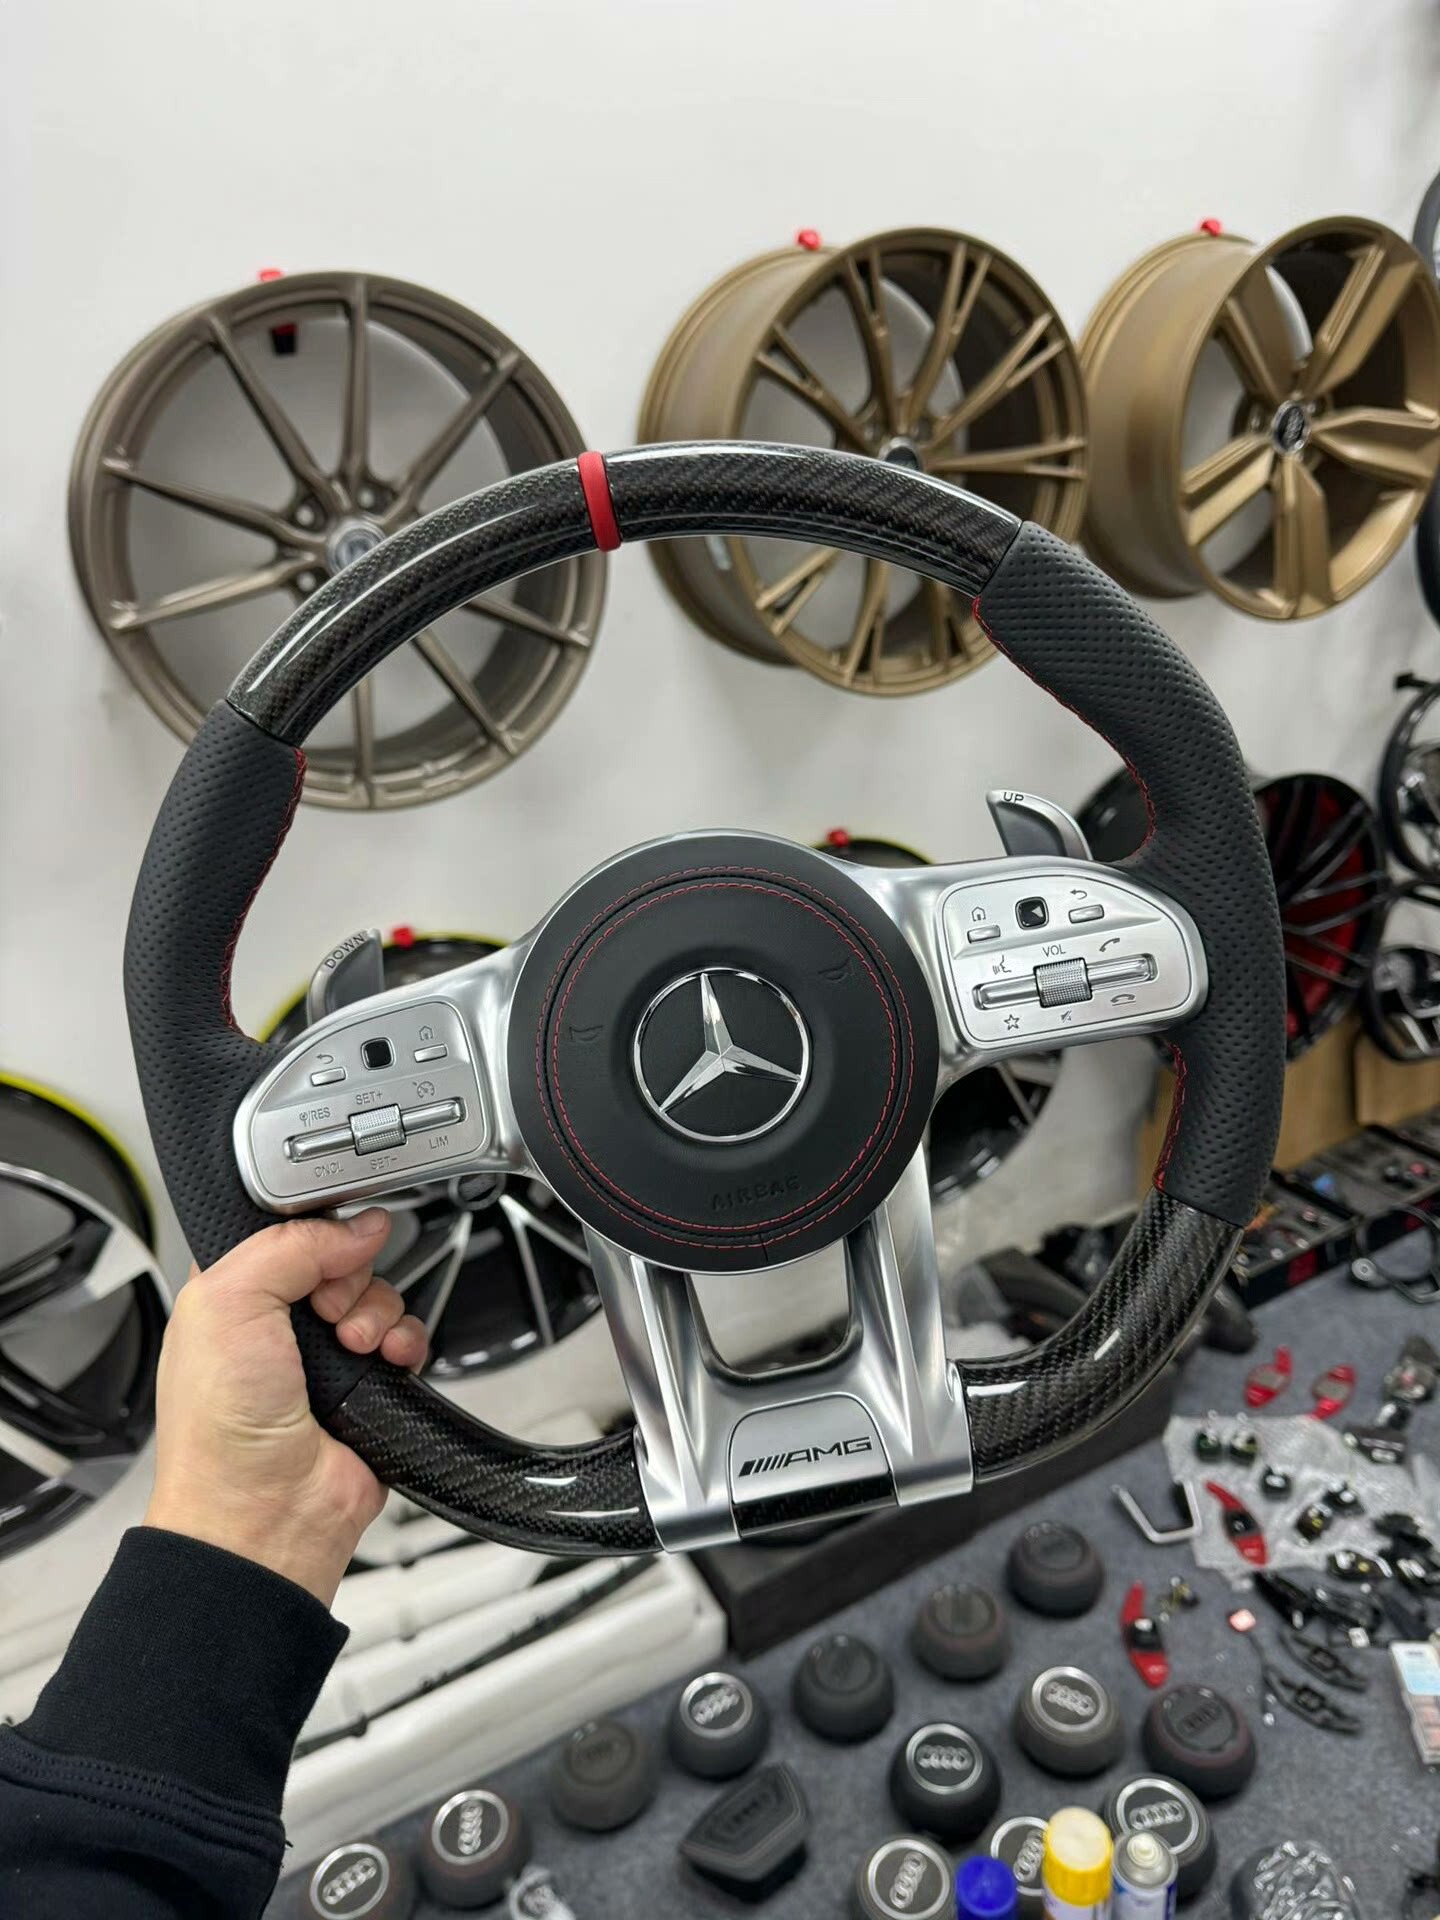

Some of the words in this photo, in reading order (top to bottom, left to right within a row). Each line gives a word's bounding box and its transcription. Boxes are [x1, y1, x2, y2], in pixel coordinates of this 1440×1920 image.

[1003, 792, 1024, 803] UP
[325, 931, 367, 969] DOWN
[1042, 944, 1066, 957] VOL
[356, 1091, 383, 1105] SET+
[429, 1135, 449, 1149] LIM
[314, 1160, 344, 1178] CNCL
[711, 1175, 801, 1211] AIRBAG
